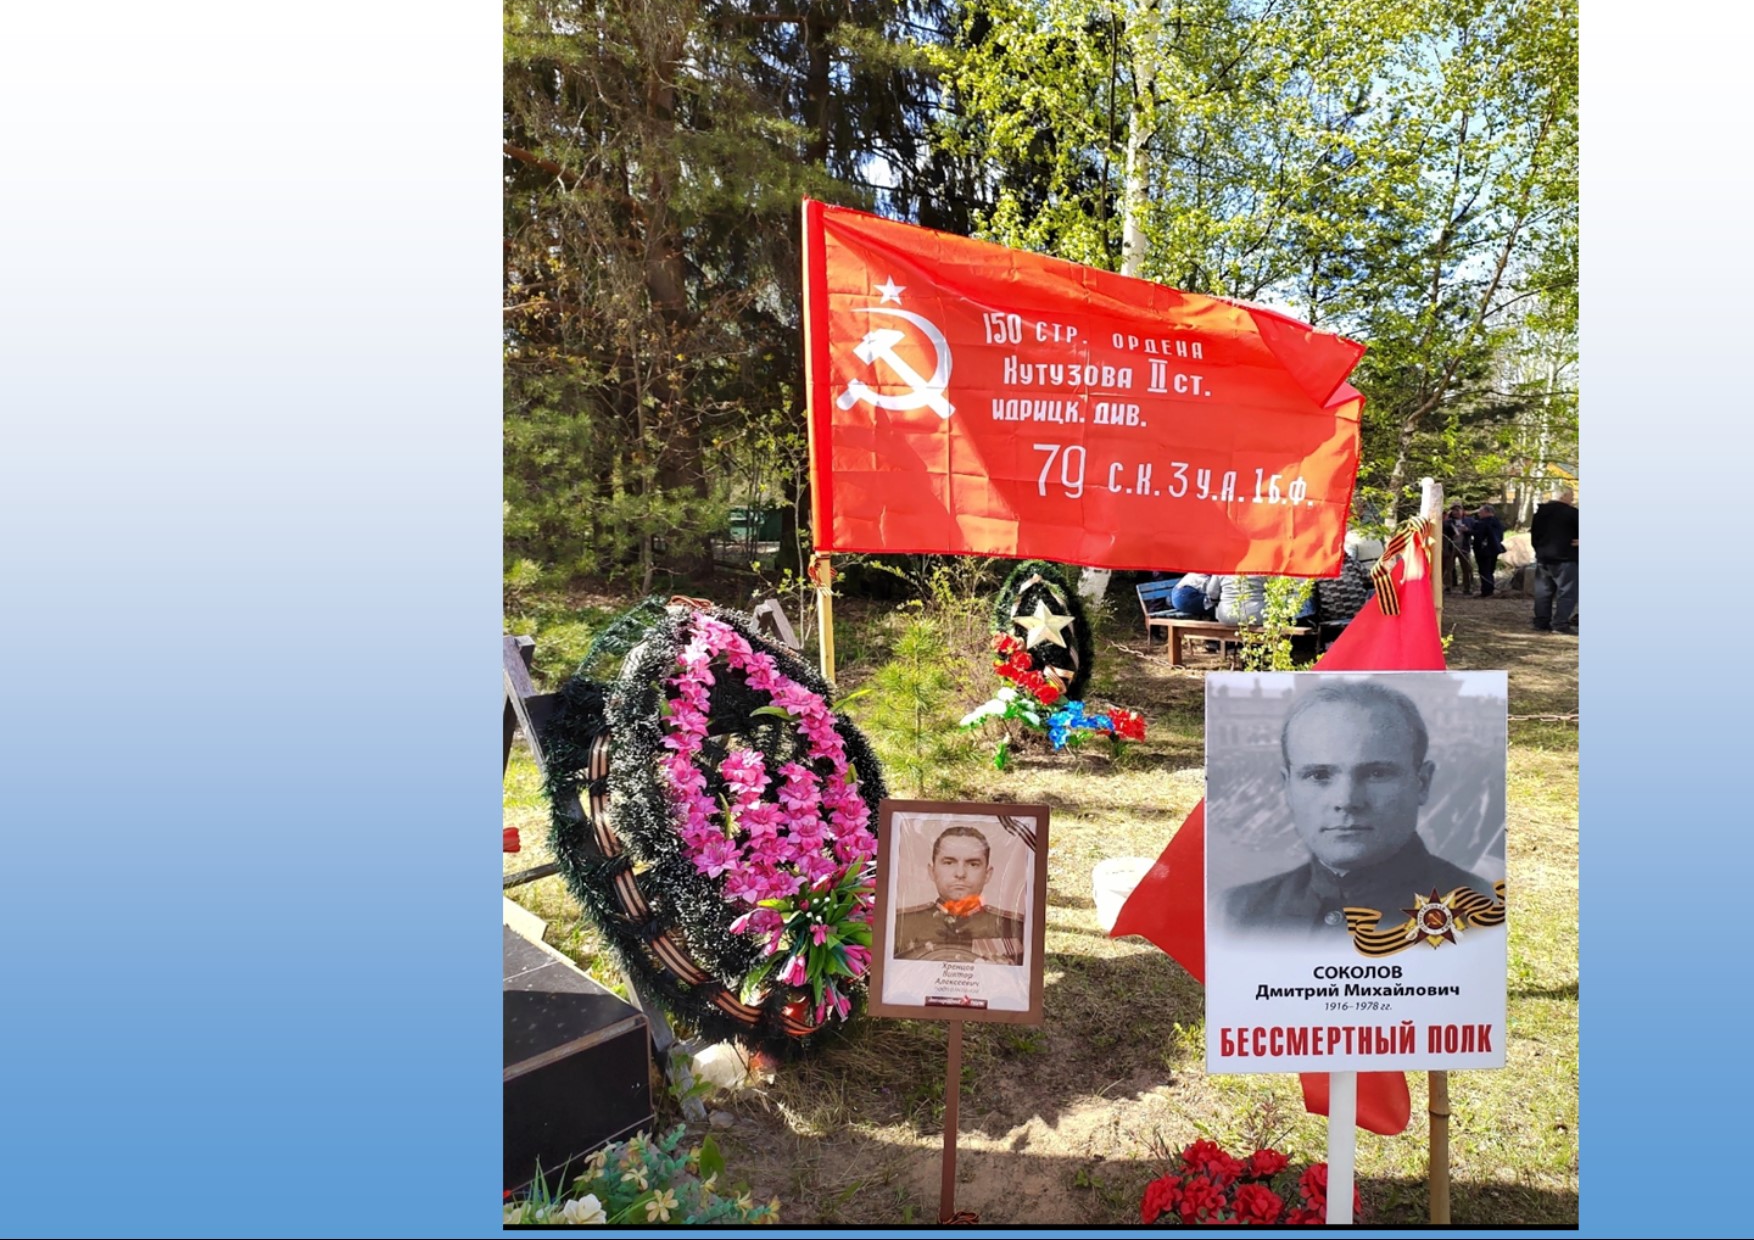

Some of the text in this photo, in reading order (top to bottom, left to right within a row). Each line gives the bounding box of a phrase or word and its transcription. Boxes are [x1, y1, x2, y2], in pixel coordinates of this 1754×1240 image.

[982, 312, 1204, 360] 150 СТР. ОРДЕНА
[991, 398, 1147, 427] ИДРИЦК. ДИВ.
[1032, 443, 1087, 499] 79
[935, 978, 980, 987] Алексеевич
[1313, 965, 1403, 980] СОКОЛОВ
[1255, 983, 1461, 1001] Дмитрий Михайлович
[1220, 1020, 1493, 1057] БЕССМЕРТНЫЙ ПОЛК
